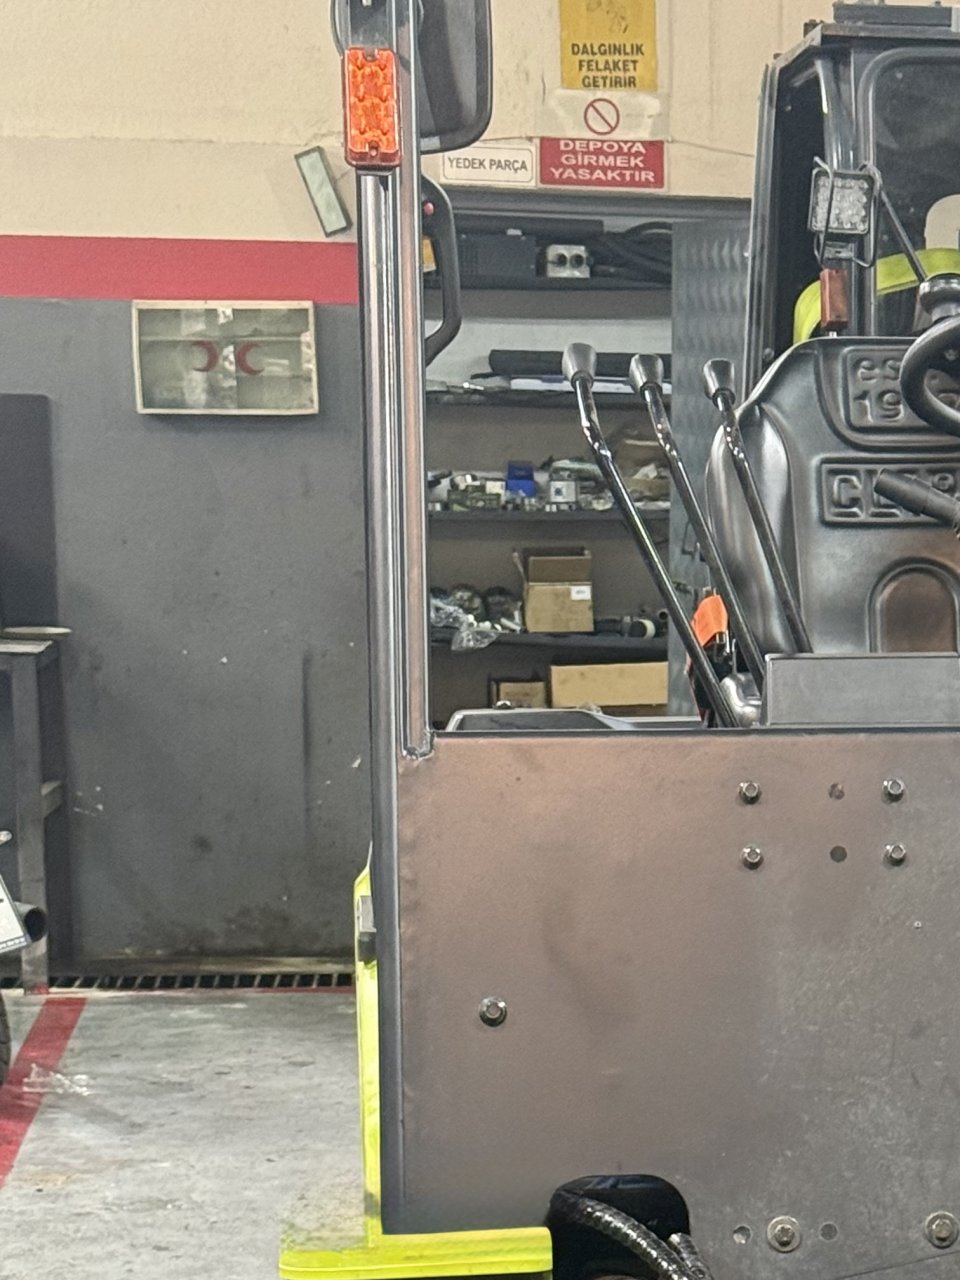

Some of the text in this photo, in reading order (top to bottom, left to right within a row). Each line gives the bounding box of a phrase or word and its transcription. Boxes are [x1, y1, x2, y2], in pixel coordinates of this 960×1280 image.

[571, 43, 645, 56] DALGINLIK
[578, 59, 639, 72] FELAKET
[560, 139, 646, 154] DEPOYA
[447, 156, 528, 174] YEDEK PARÇA
[561, 152, 645, 168] GİRMEK
[550, 167, 655, 182] YASAKTIR
